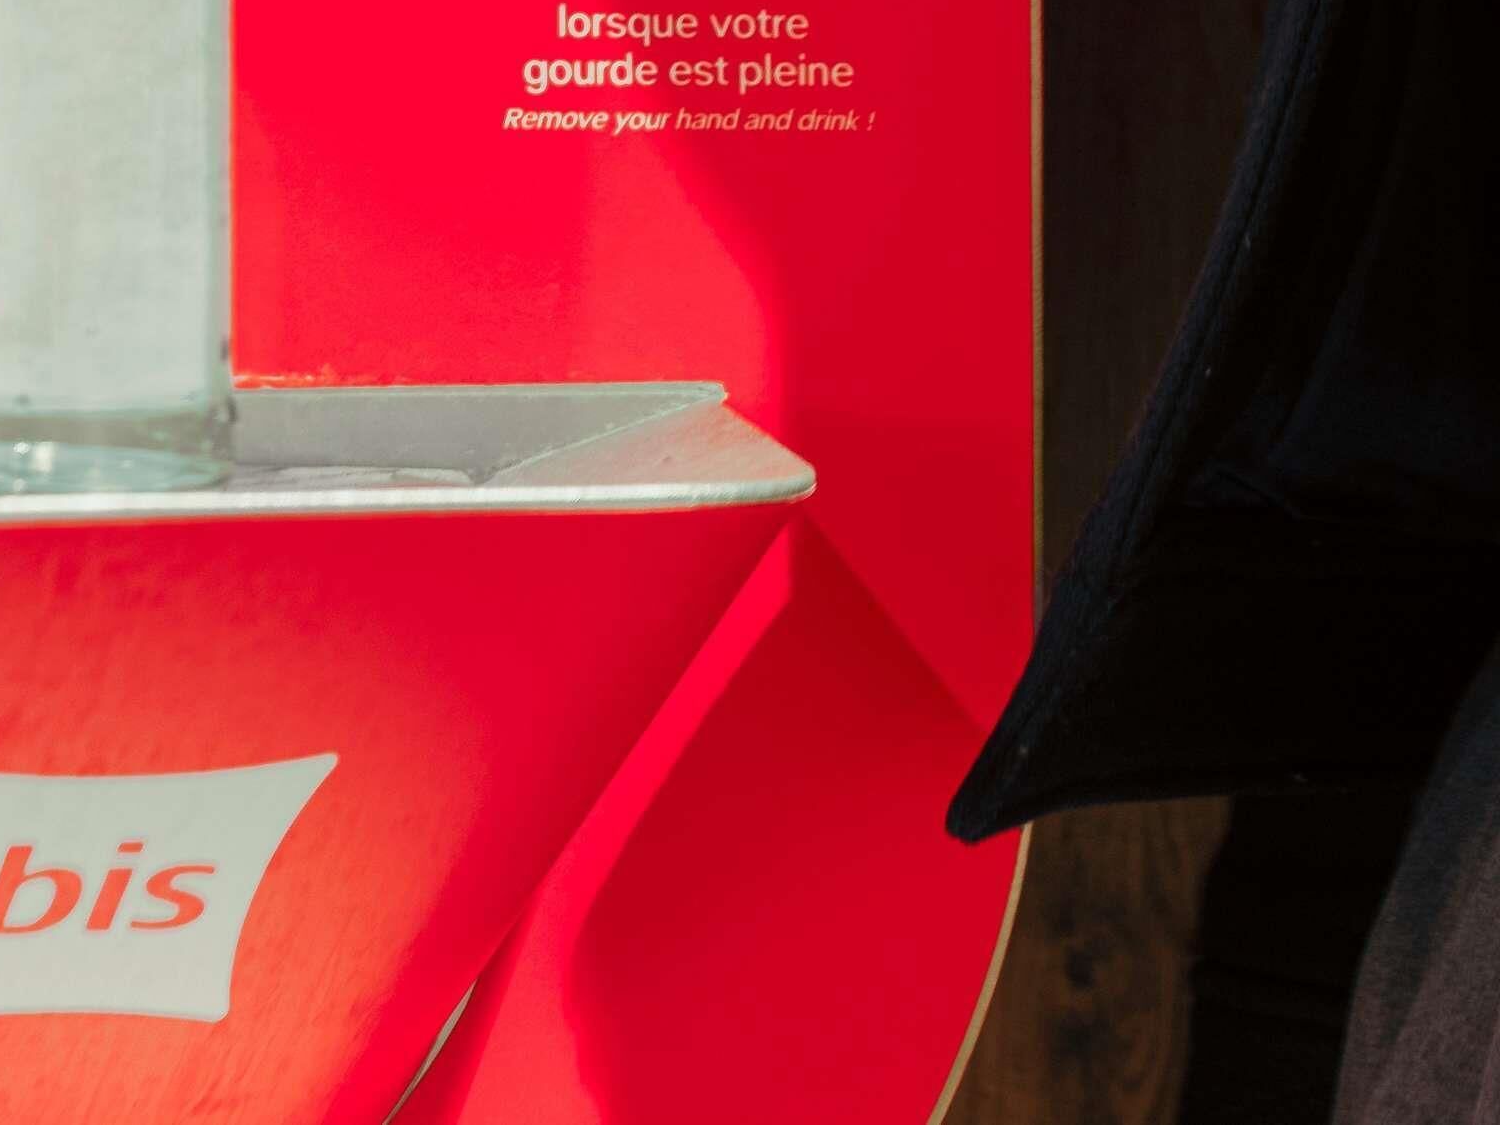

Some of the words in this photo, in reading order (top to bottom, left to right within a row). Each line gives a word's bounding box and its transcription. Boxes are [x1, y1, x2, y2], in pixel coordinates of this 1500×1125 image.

[556, 2, 699, 47] lorsque
[709, 9, 810, 40] votre
[522, 51, 659, 96] gourde
[668, 56, 729, 87] est
[738, 52, 855, 96] pleine
[502, 106, 611, 132] Remove
[611, 111, 671, 137] your
[674, 106, 741, 131] hand
[743, 108, 795, 132] and
[796, 108, 860, 131] drink
